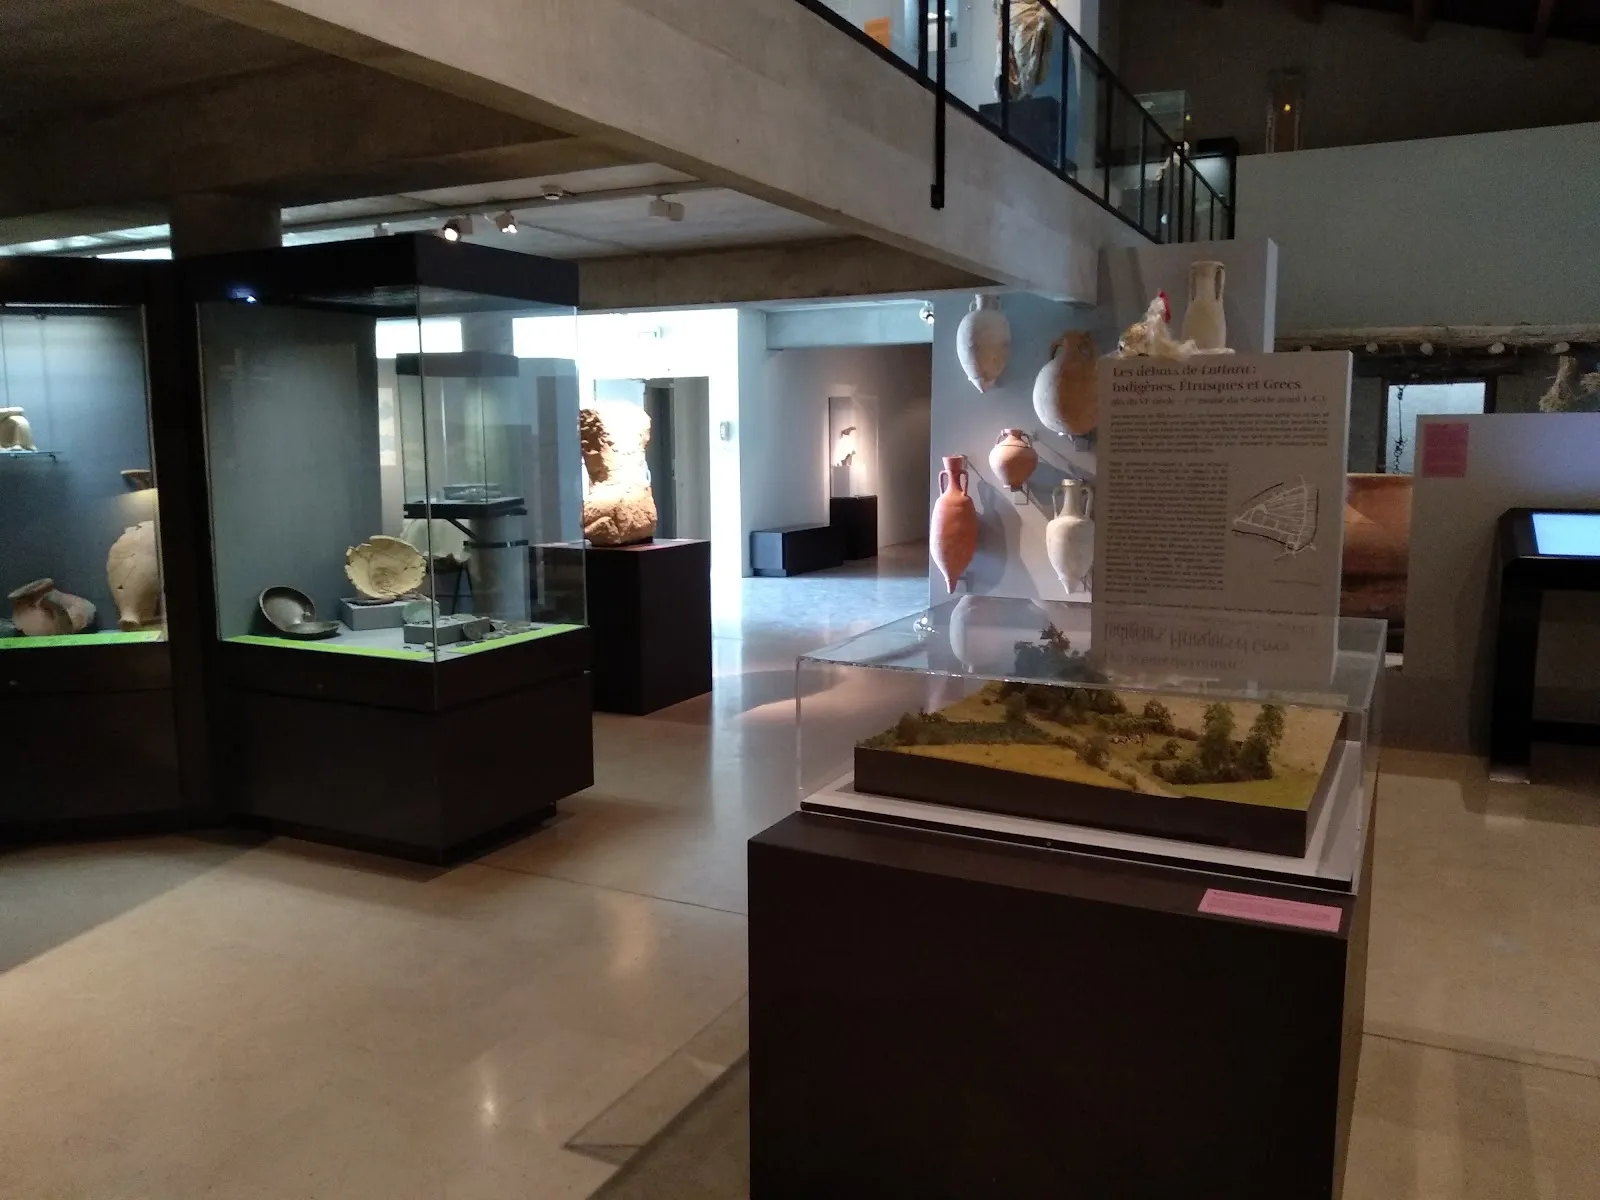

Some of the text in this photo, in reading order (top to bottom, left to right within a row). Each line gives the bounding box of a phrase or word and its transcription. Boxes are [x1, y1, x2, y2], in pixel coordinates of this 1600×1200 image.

[1112, 367, 1133, 378] Les
[1182, 364, 1198, 376] de
[1247, 380, 1259, 390] et
[1263, 378, 1302, 390] Grecs
